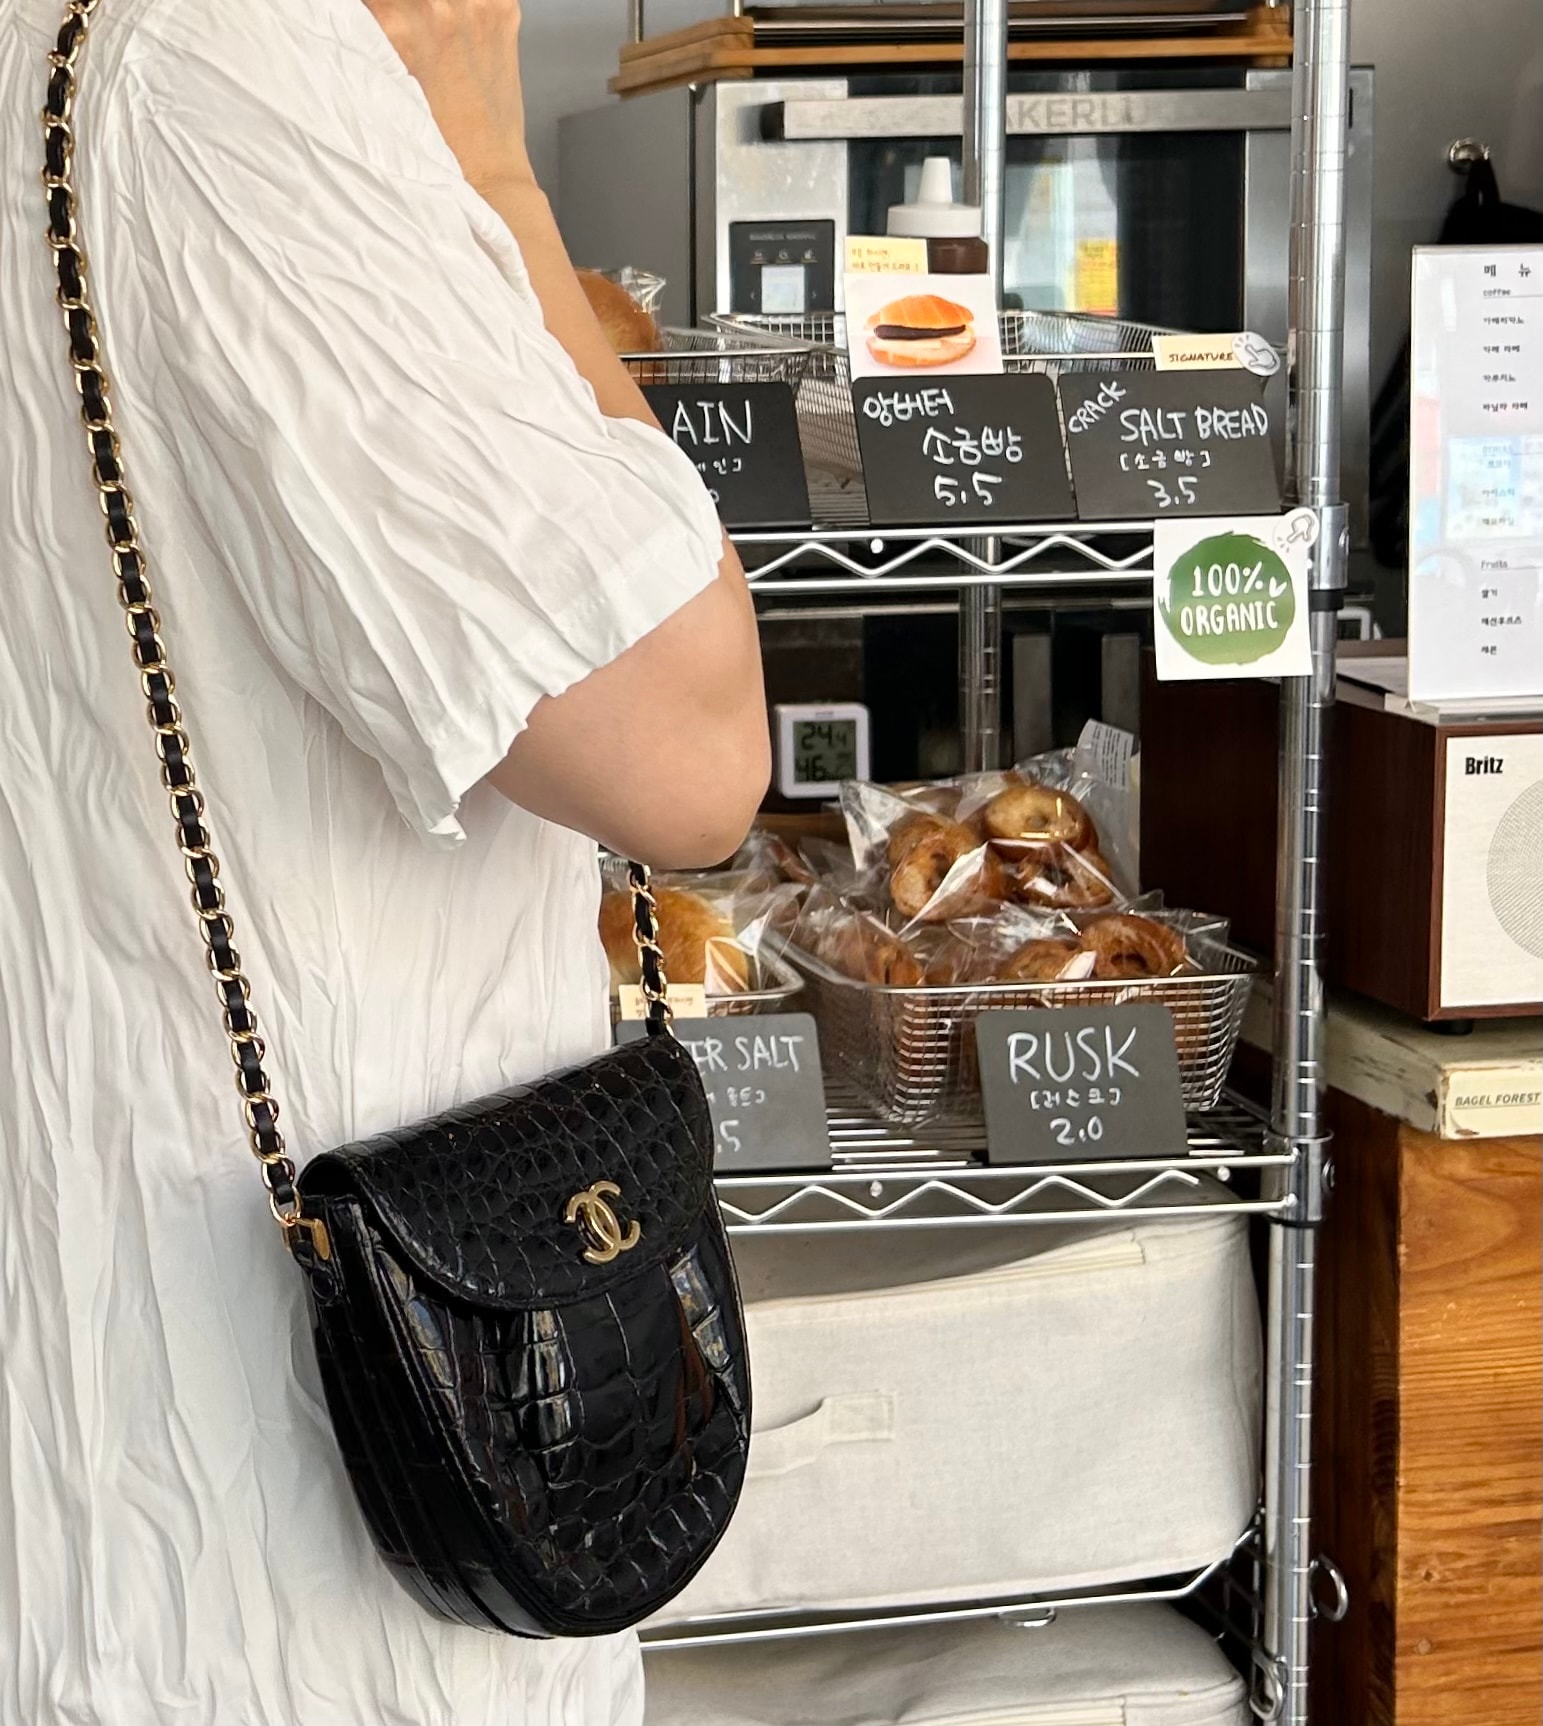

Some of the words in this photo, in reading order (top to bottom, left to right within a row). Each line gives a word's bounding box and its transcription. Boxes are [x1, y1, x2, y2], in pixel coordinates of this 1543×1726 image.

[1169, 352, 1233, 363] SIGNATURE
[672, 400, 752, 446] AIN
[863, 388, 954, 427] 앙버터
[1068, 380, 1127, 434] CRACK
[1119, 407, 1186, 446] SALT
[1195, 402, 1268, 440] BREAD
[923, 426, 1023, 465] 소금빵
[934, 472, 1002, 507] 5.5
[1147, 476, 1198, 508] 3.5
[1192, 561, 1264, 597] 100%
[1180, 601, 1278, 636] ORGANIC
[1465, 755, 1504, 775] Britz
[735, 1035, 804, 1072] SALT
[1007, 1025, 1140, 1084] RUSK
[1455, 1095, 1492, 1107] BAGEL
[1495, 1092, 1541, 1105] FOREST
[717, 1119, 741, 1153] .5
[1050, 1115, 1103, 1145] 2.0
